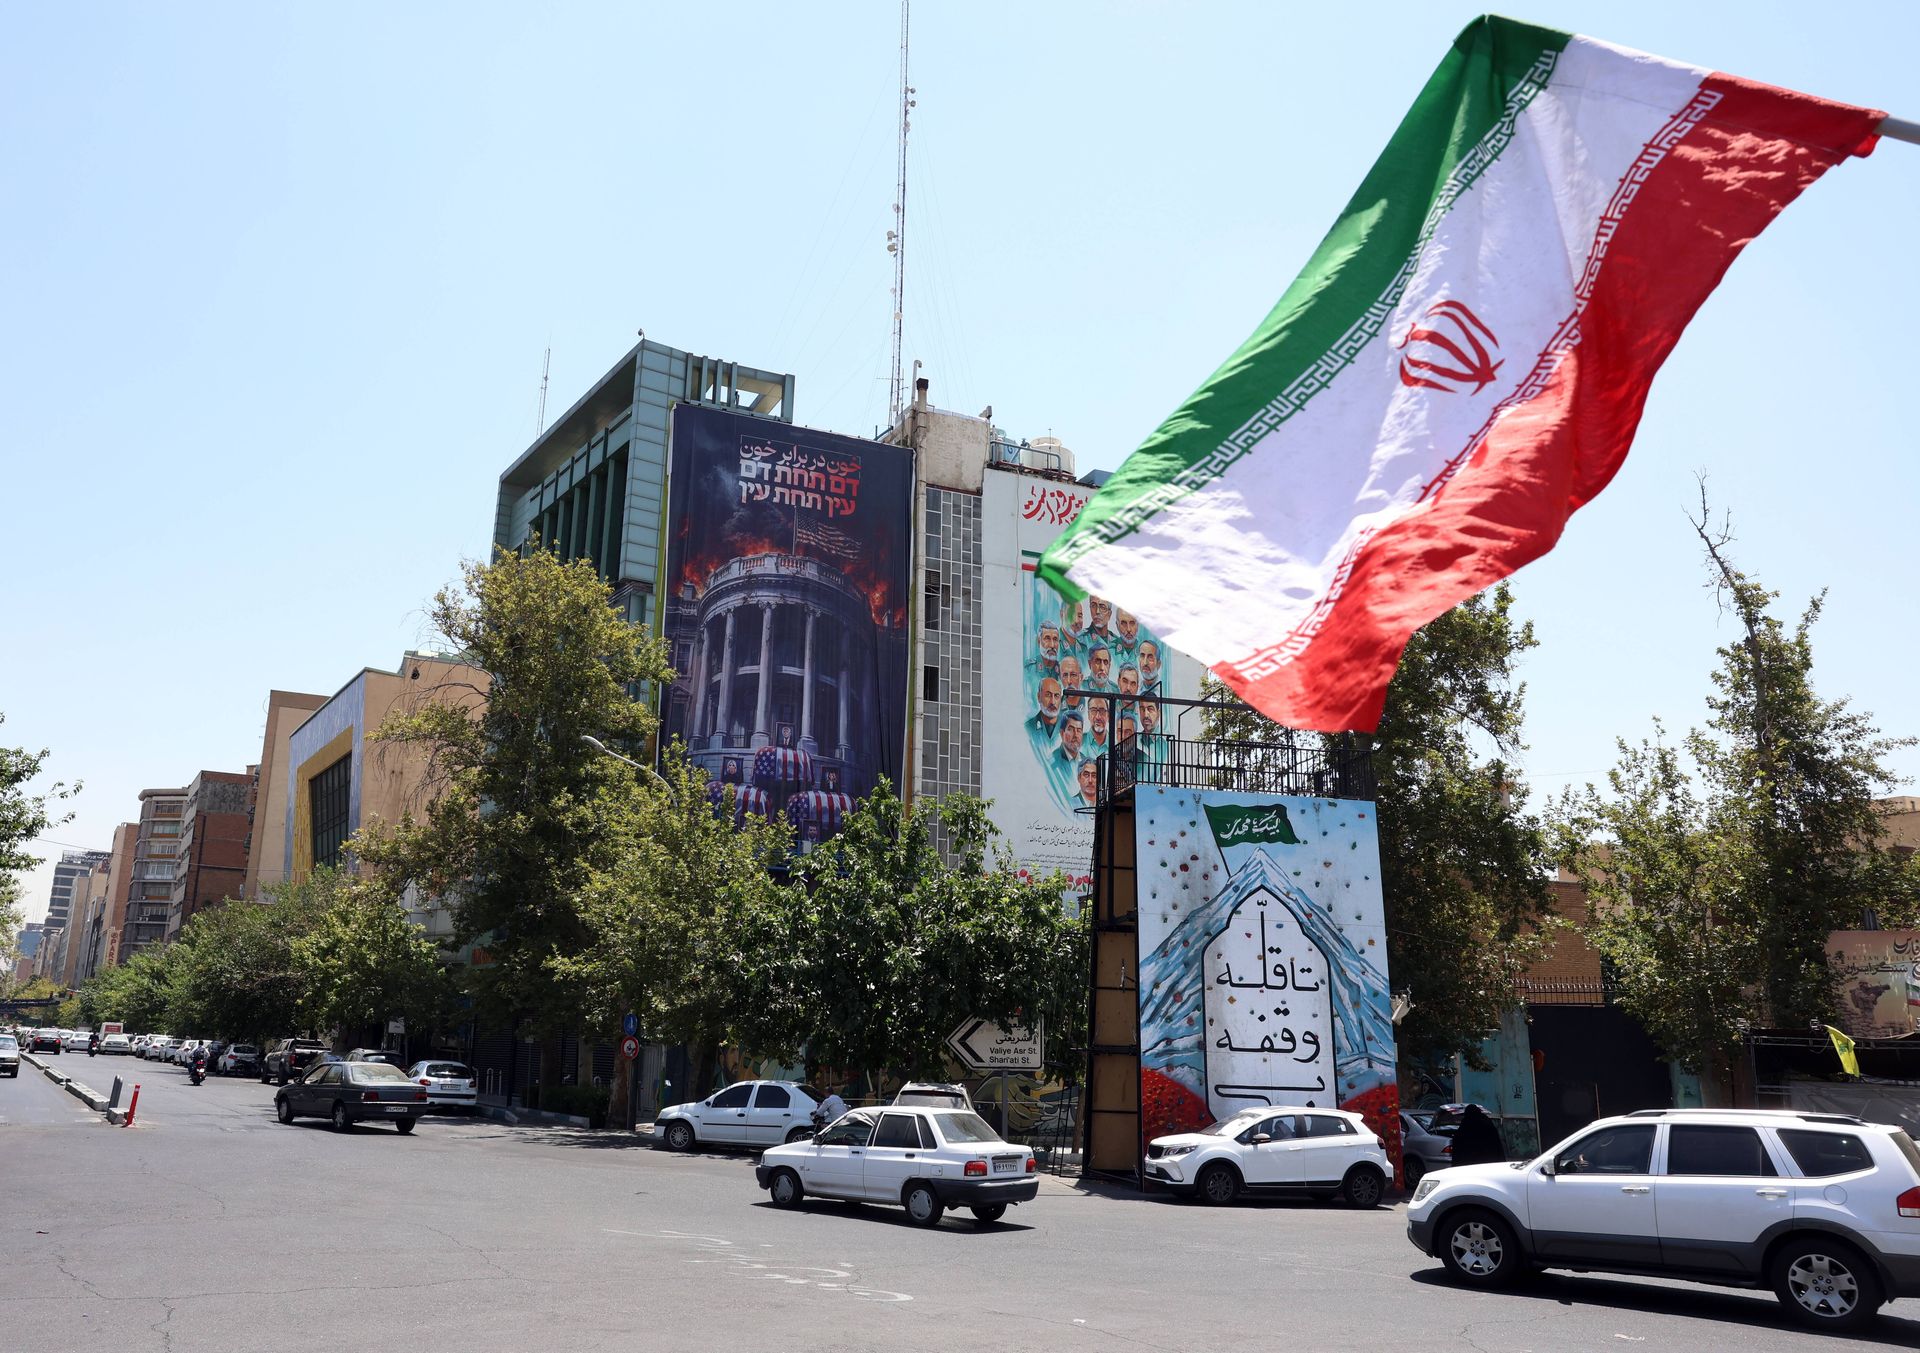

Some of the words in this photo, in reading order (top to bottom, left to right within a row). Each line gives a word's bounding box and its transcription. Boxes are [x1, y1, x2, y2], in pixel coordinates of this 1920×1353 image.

[739, 440, 776, 460] خون
[776, 445, 808, 470] برابر
[739, 458, 772, 480] דם
[809, 454, 826, 472] در
[827, 455, 862, 476] خون
[775, 464, 826, 492] תחת
[829, 474, 861, 497] דם
[738, 480, 771, 503] עין
[772, 486, 822, 511] תחת
[825, 495, 856, 518] עין
[995, 1033, 1032, 1045] شریعتی
[989, 1047, 1012, 1055] Valiye
[1013, 1047, 1026, 1055] Asr
[1027, 1047, 1038, 1055] St.
[1021, 1056, 1031, 1064] St.
